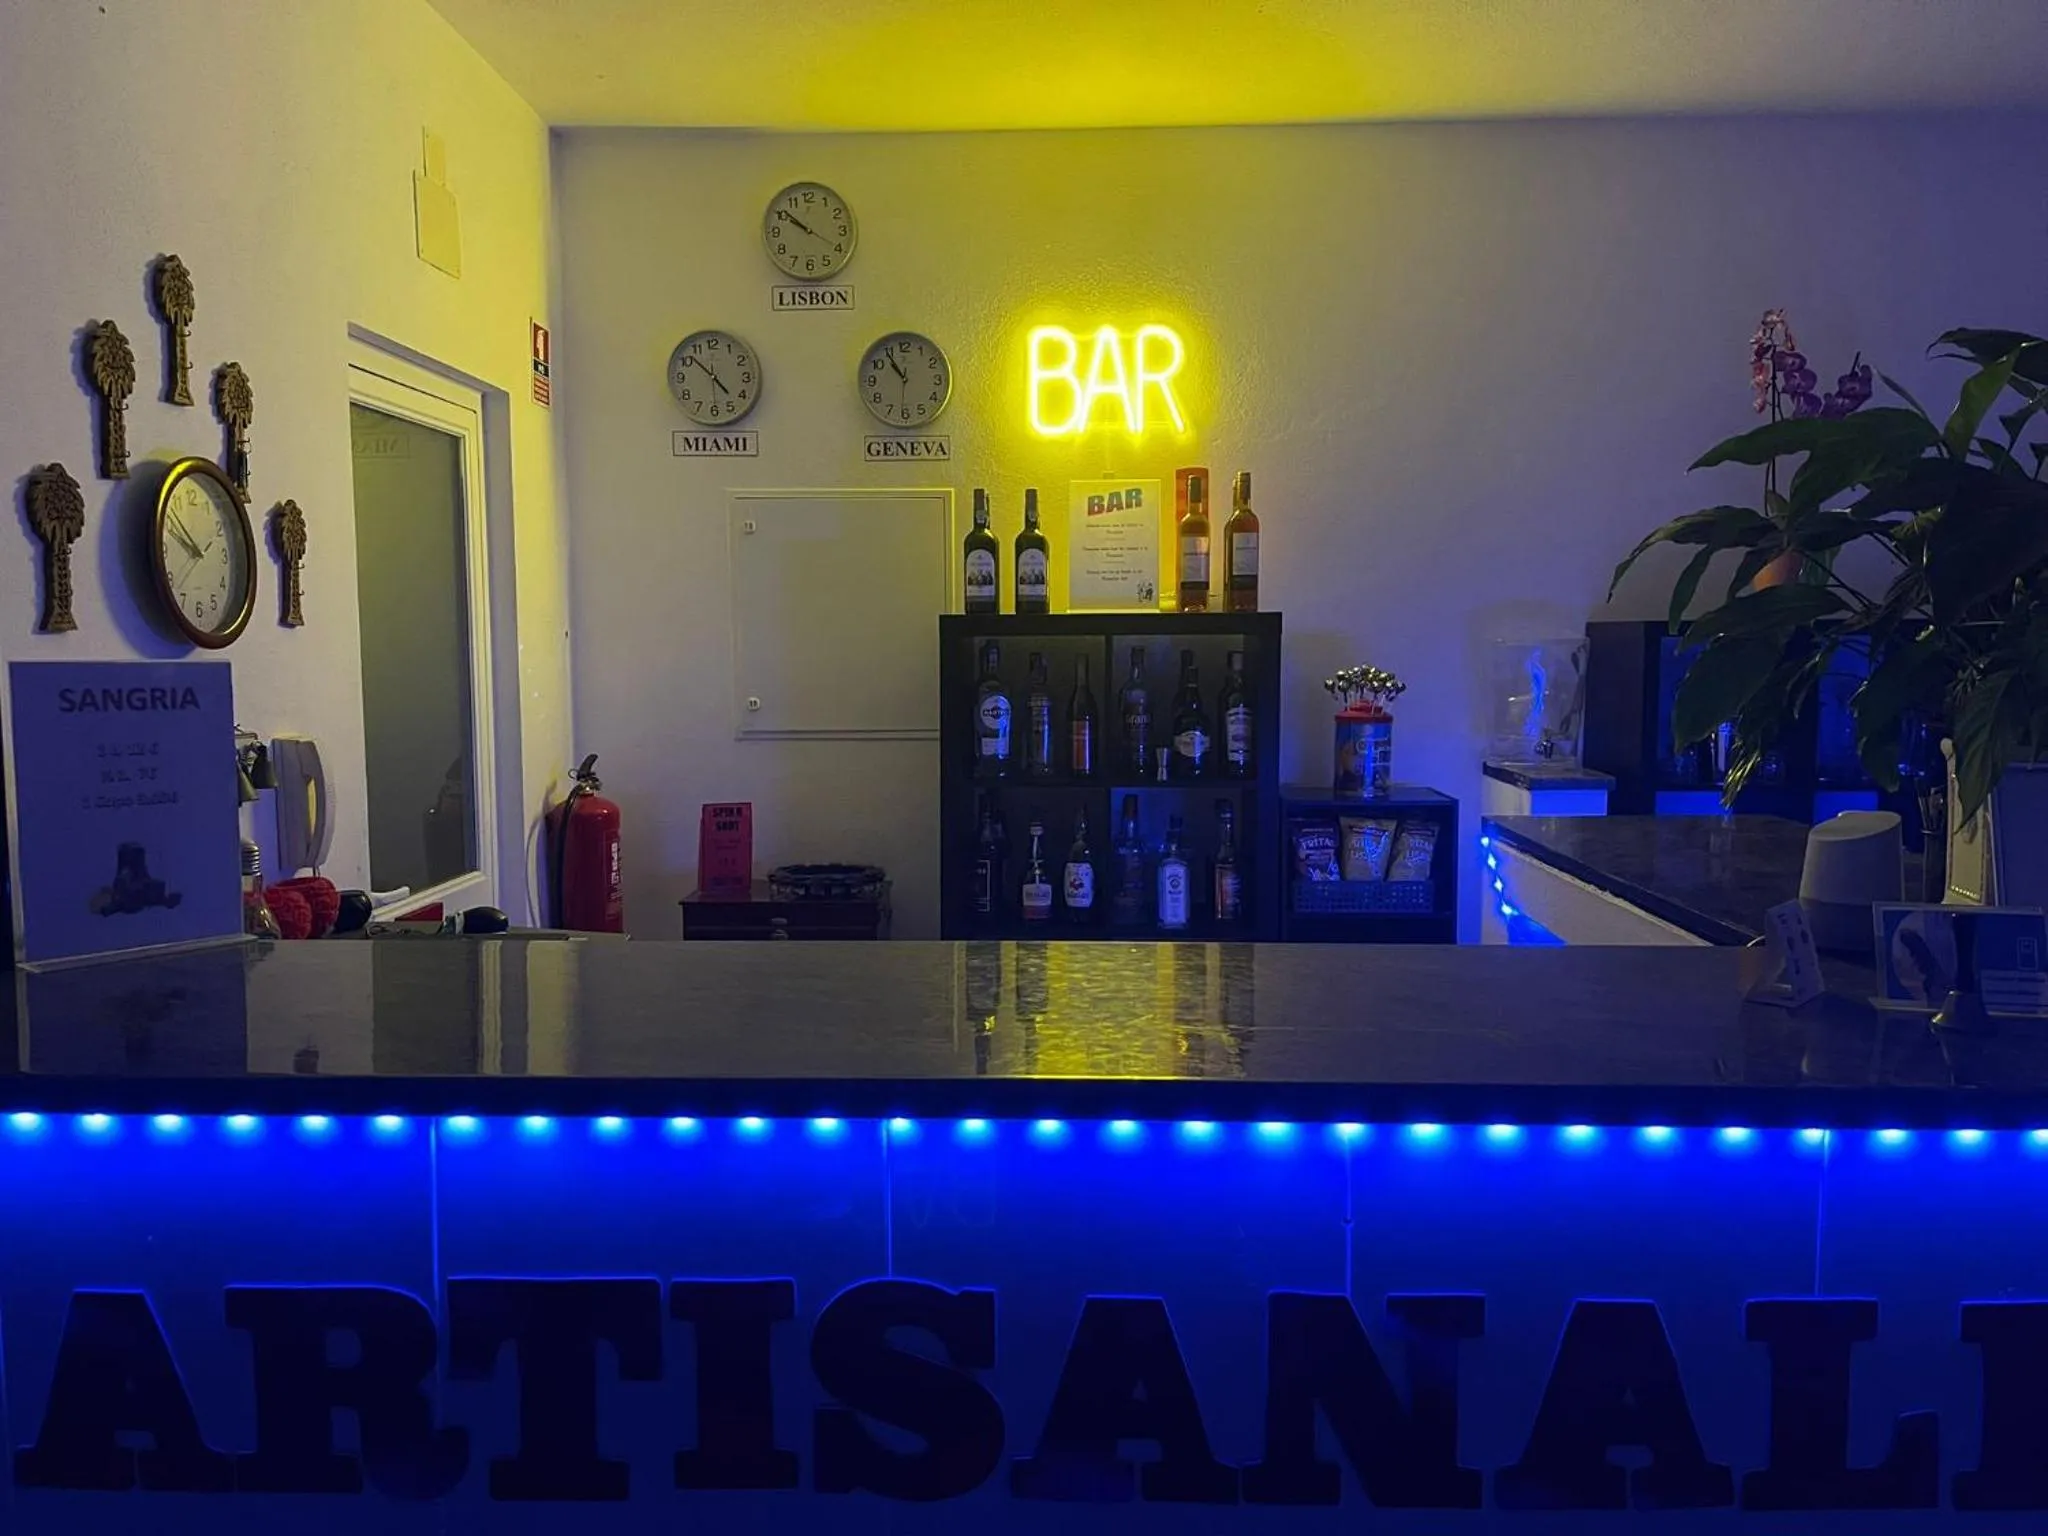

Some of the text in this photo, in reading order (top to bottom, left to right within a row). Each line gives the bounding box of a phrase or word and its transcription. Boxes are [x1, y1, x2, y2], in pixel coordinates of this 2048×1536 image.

[788, 198, 799, 207] 11
[801, 192, 815, 203] 12
[822, 198, 828, 207] 1
[833, 209, 841, 219] 2
[772, 227, 780, 237] 9
[838, 226, 847, 236] 3
[778, 244, 786, 254] 8
[834, 244, 843, 253] 4
[790, 257, 798, 267] 7
[806, 260, 814, 270] 6
[822, 256, 830, 266] 5
[779, 291, 848, 306] LISBON
[692, 343, 702, 353] 11
[707, 339, 718, 349] 12
[727, 343, 732, 352] 1
[899, 342, 910, 352] 12
[918, 347, 924, 355] 1
[682, 356, 693, 365] 10
[737, 355, 745, 365] 2
[872, 360, 884, 369] 10
[929, 358, 937, 368] 2
[677, 372, 685, 382] 9
[743, 372, 750, 381] 3
[868, 376, 876, 386] 9
[934, 375, 941, 385] 3
[1028, 325, 1185, 435] BAR
[682, 389, 690, 399] 8
[739, 389, 746, 398] 4
[873, 393, 881, 402] 8
[929, 392, 937, 401] 4
[695, 401, 703, 411] 7
[711, 405, 719, 415] 6
[727, 401, 734, 411] 5
[886, 405, 893, 415] 7
[917, 404, 925, 414] 5
[901, 409, 909, 419] 6
[683, 437, 748, 451] MIAMI
[867, 442, 947, 457] GENEVA
[186, 490, 197, 506] 12
[1087, 488, 1143, 516] BAR
[205, 502, 210, 514] 1
[216, 521, 223, 537] 2
[222, 549, 228, 564] 3
[220, 576, 225, 589] 4
[180, 593, 186, 609] 7
[210, 595, 217, 611] 5
[196, 602, 203, 618] 6
[58, 687, 200, 712] SANGRIA
